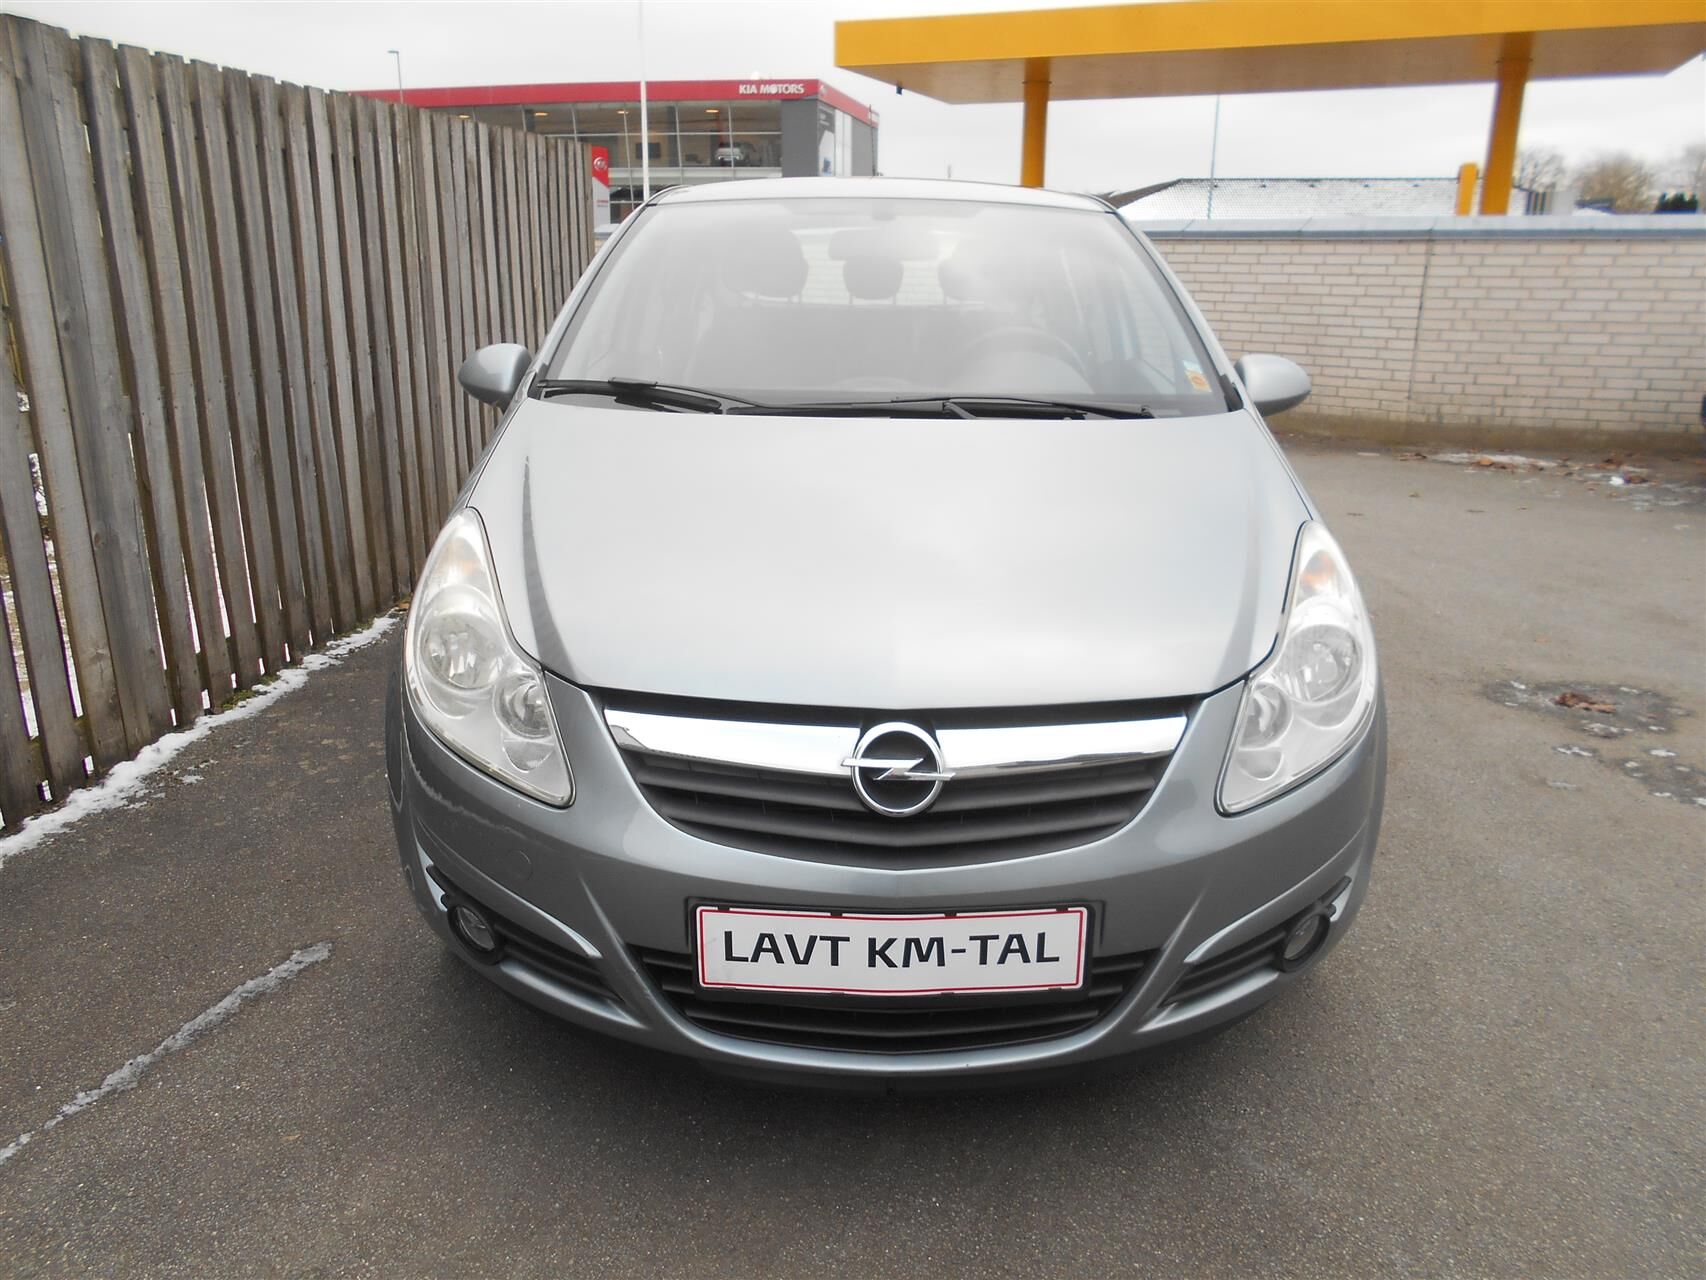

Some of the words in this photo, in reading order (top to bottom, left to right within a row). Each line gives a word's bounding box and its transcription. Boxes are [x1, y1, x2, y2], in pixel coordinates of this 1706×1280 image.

[739, 84, 758, 94] KIA
[760, 83, 805, 94] MOTORS
[724, 930, 850, 967] LAVT
[868, 932, 1060, 968] KM-TAL
